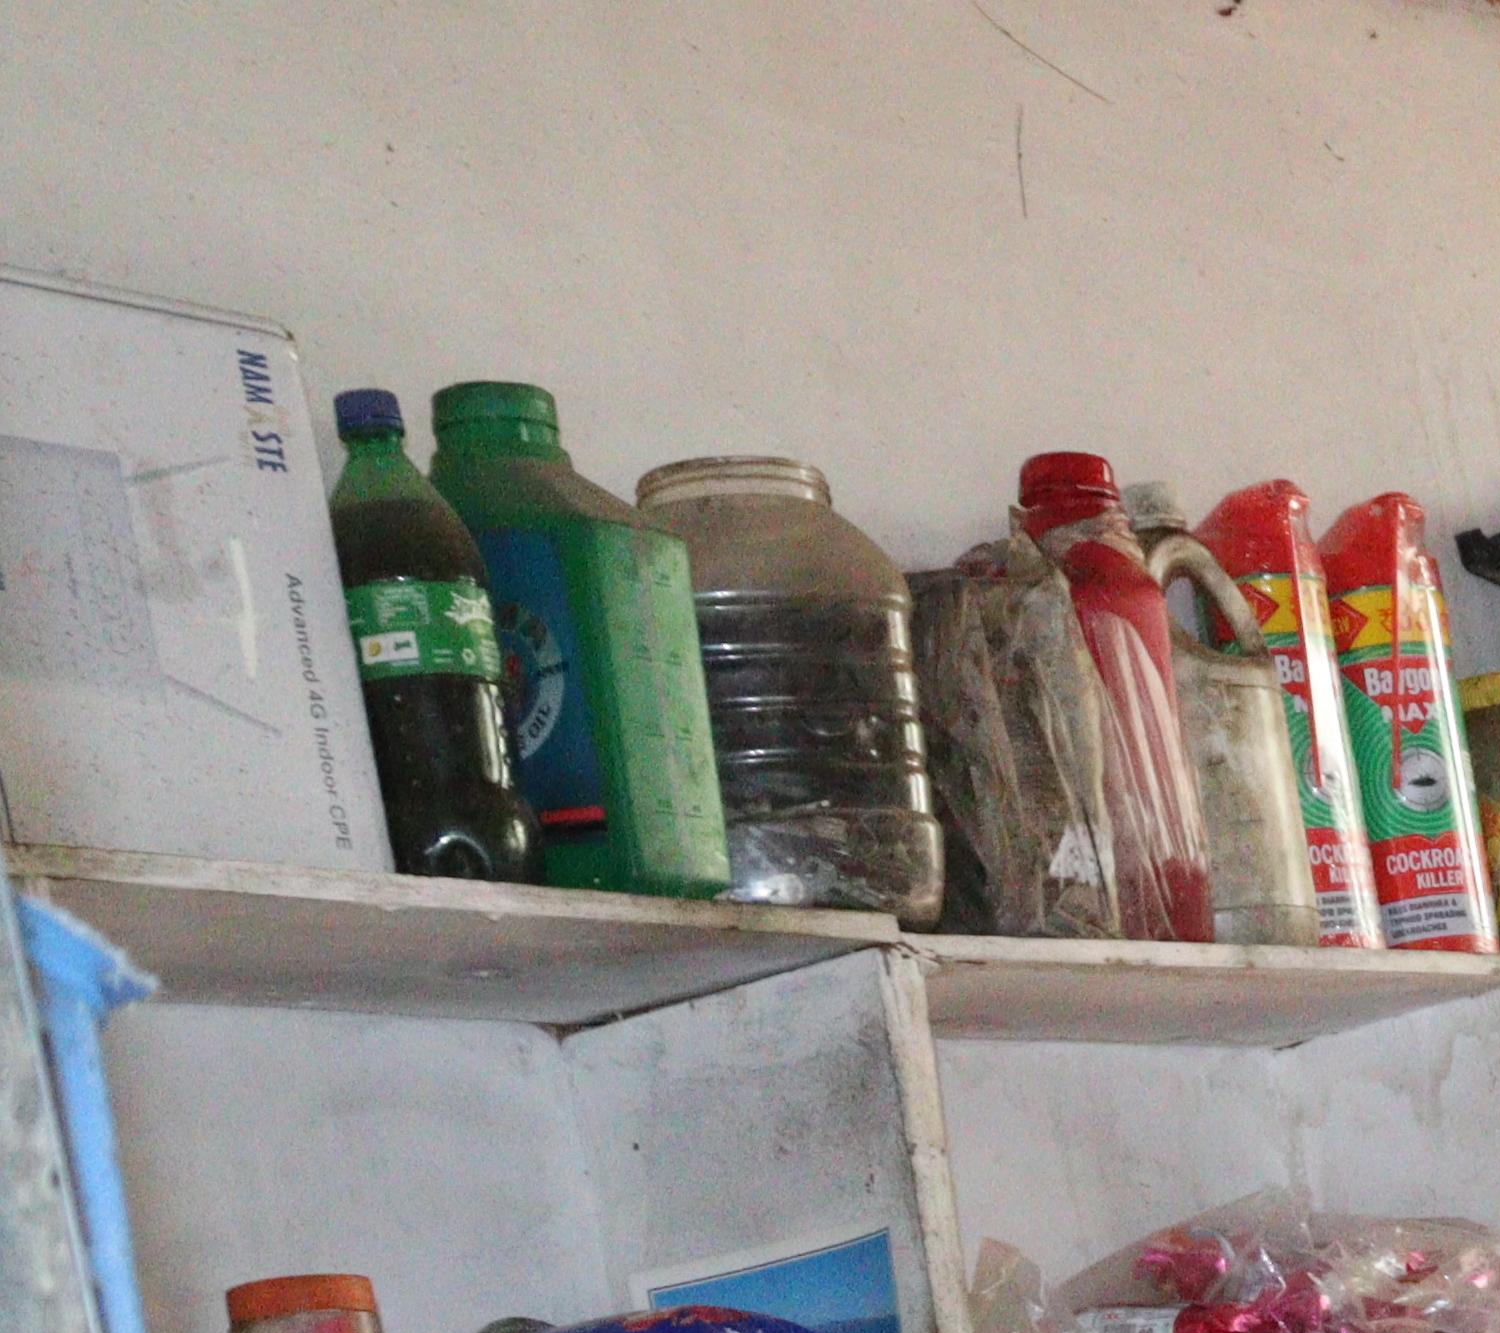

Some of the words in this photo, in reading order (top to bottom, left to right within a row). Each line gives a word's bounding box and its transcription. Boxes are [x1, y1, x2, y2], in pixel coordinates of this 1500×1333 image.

[285, 572, 320, 697] Advanced
[306, 689, 328, 719] 4G
[313, 726, 340, 811] Indoor
[327, 805, 353, 851] CPE
[1415, 870, 1465, 889] KILLER
